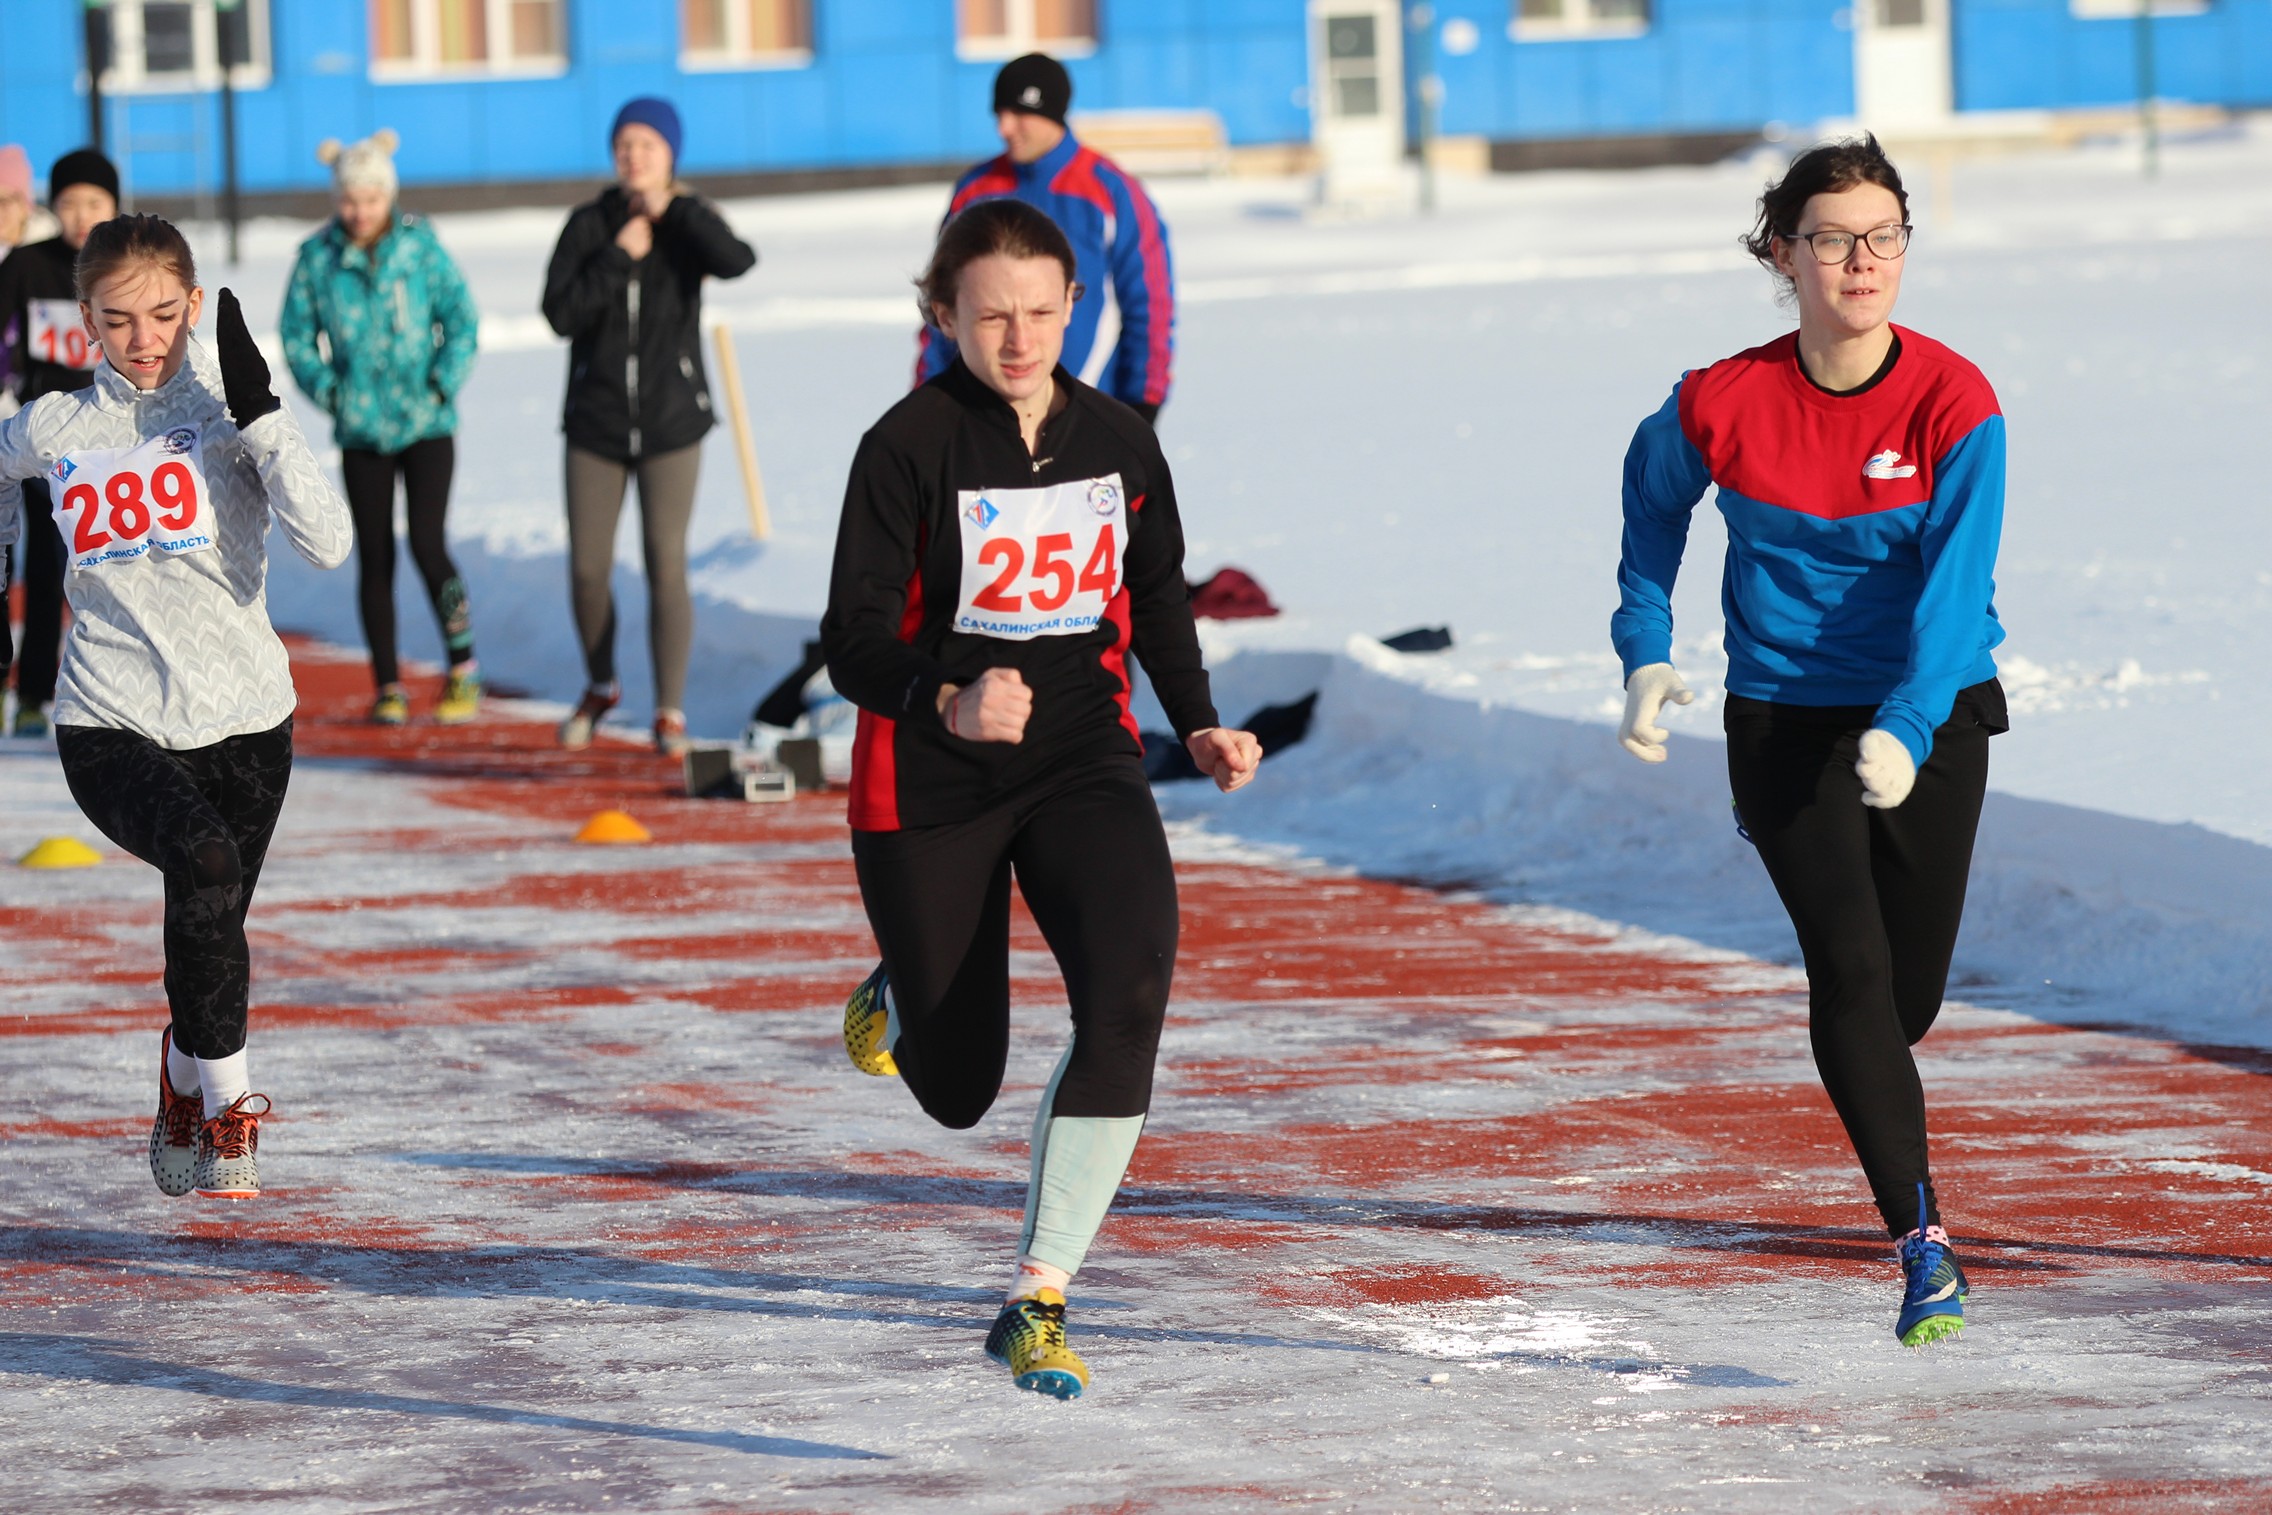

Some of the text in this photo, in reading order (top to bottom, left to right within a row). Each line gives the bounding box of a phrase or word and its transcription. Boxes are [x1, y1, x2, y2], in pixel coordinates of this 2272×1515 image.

[39, 324, 103, 368] 10
[62, 461, 198, 554] 289
[79, 538, 155, 567] САХАЛИНСКАЯ
[971, 523, 1117, 613] 254
[960, 616, 1060, 634] САХАЛИНСКАЯ
